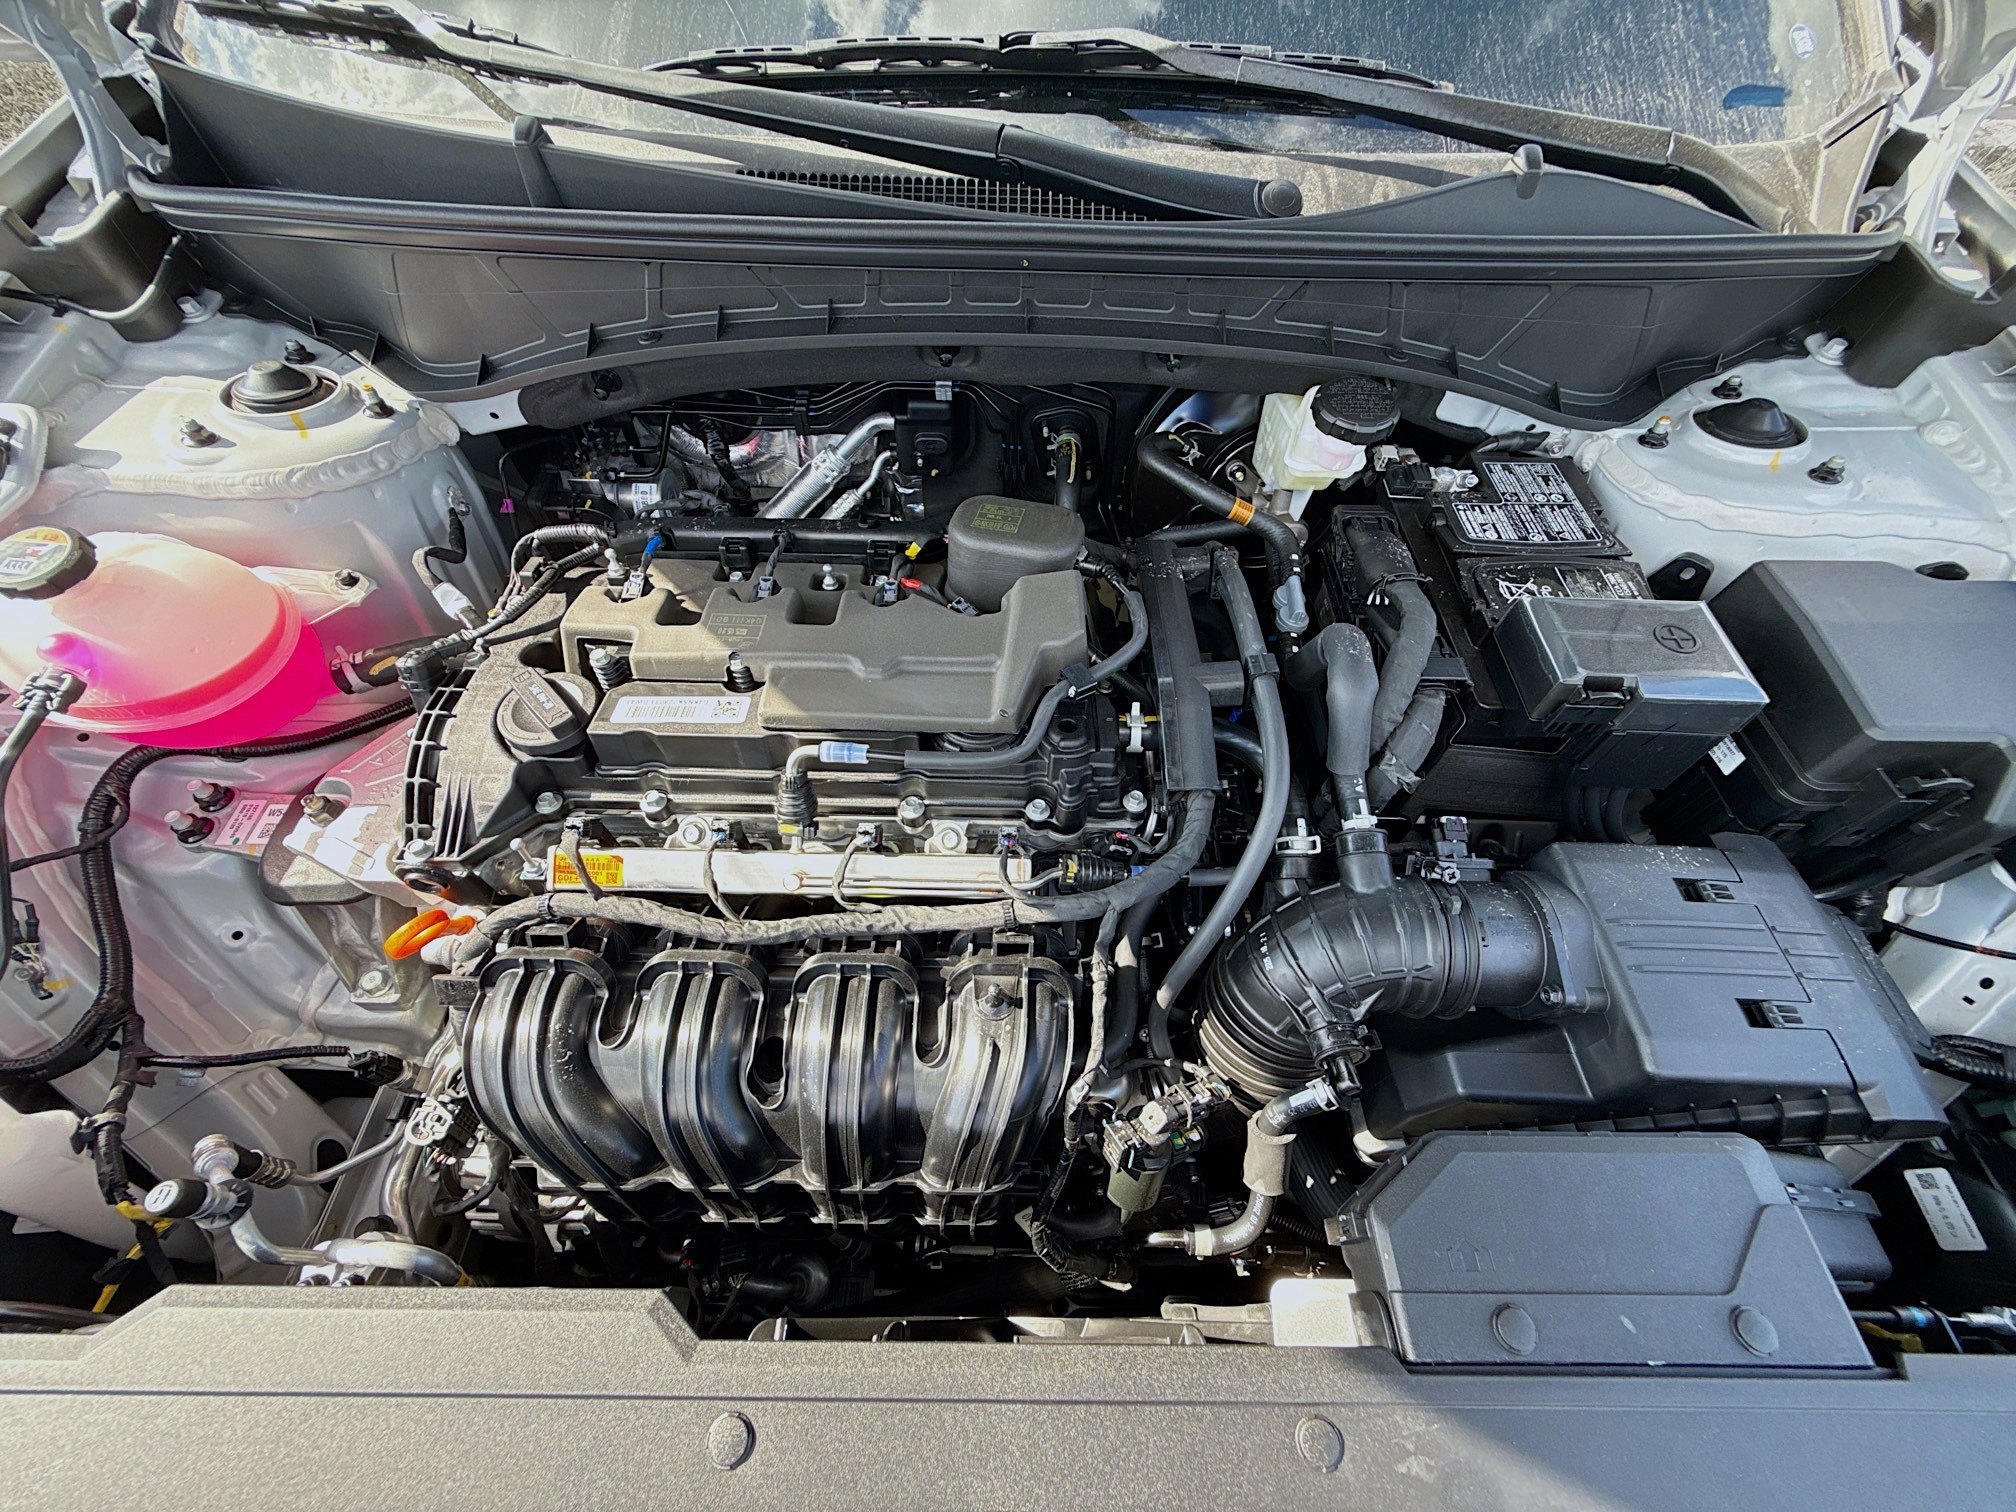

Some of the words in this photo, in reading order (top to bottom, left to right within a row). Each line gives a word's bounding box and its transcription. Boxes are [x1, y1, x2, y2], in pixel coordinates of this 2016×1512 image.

[267, 808, 287, 817] W5
[557, 874, 572, 882] GDI
[152, 1188, 171, 1205] H
